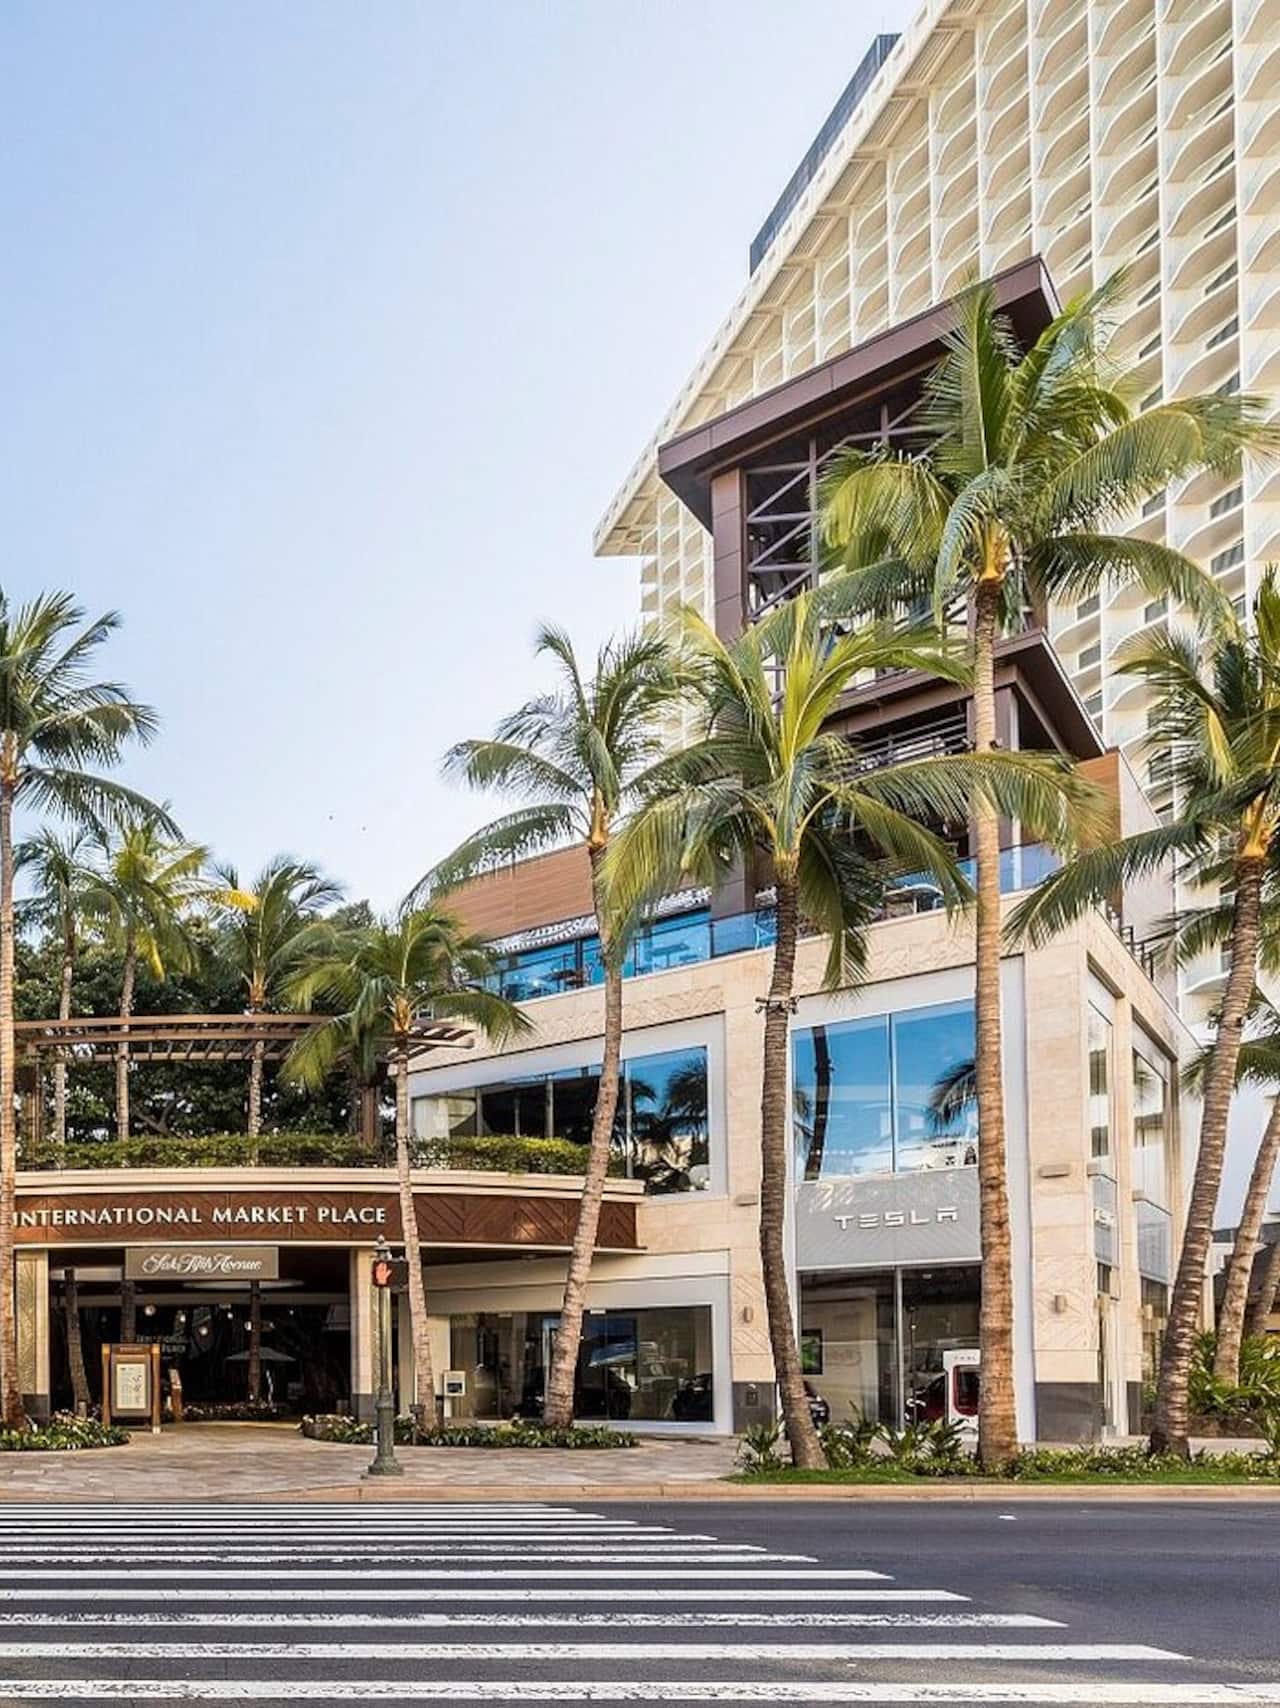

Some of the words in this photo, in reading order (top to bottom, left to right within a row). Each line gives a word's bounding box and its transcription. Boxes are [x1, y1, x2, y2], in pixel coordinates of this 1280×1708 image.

[12, 1207, 202, 1226] INTERNATIONAL
[212, 1206, 308, 1223] MARKET
[317, 1207, 386, 1223] PLACE
[833, 1206, 958, 1231] TESLA
